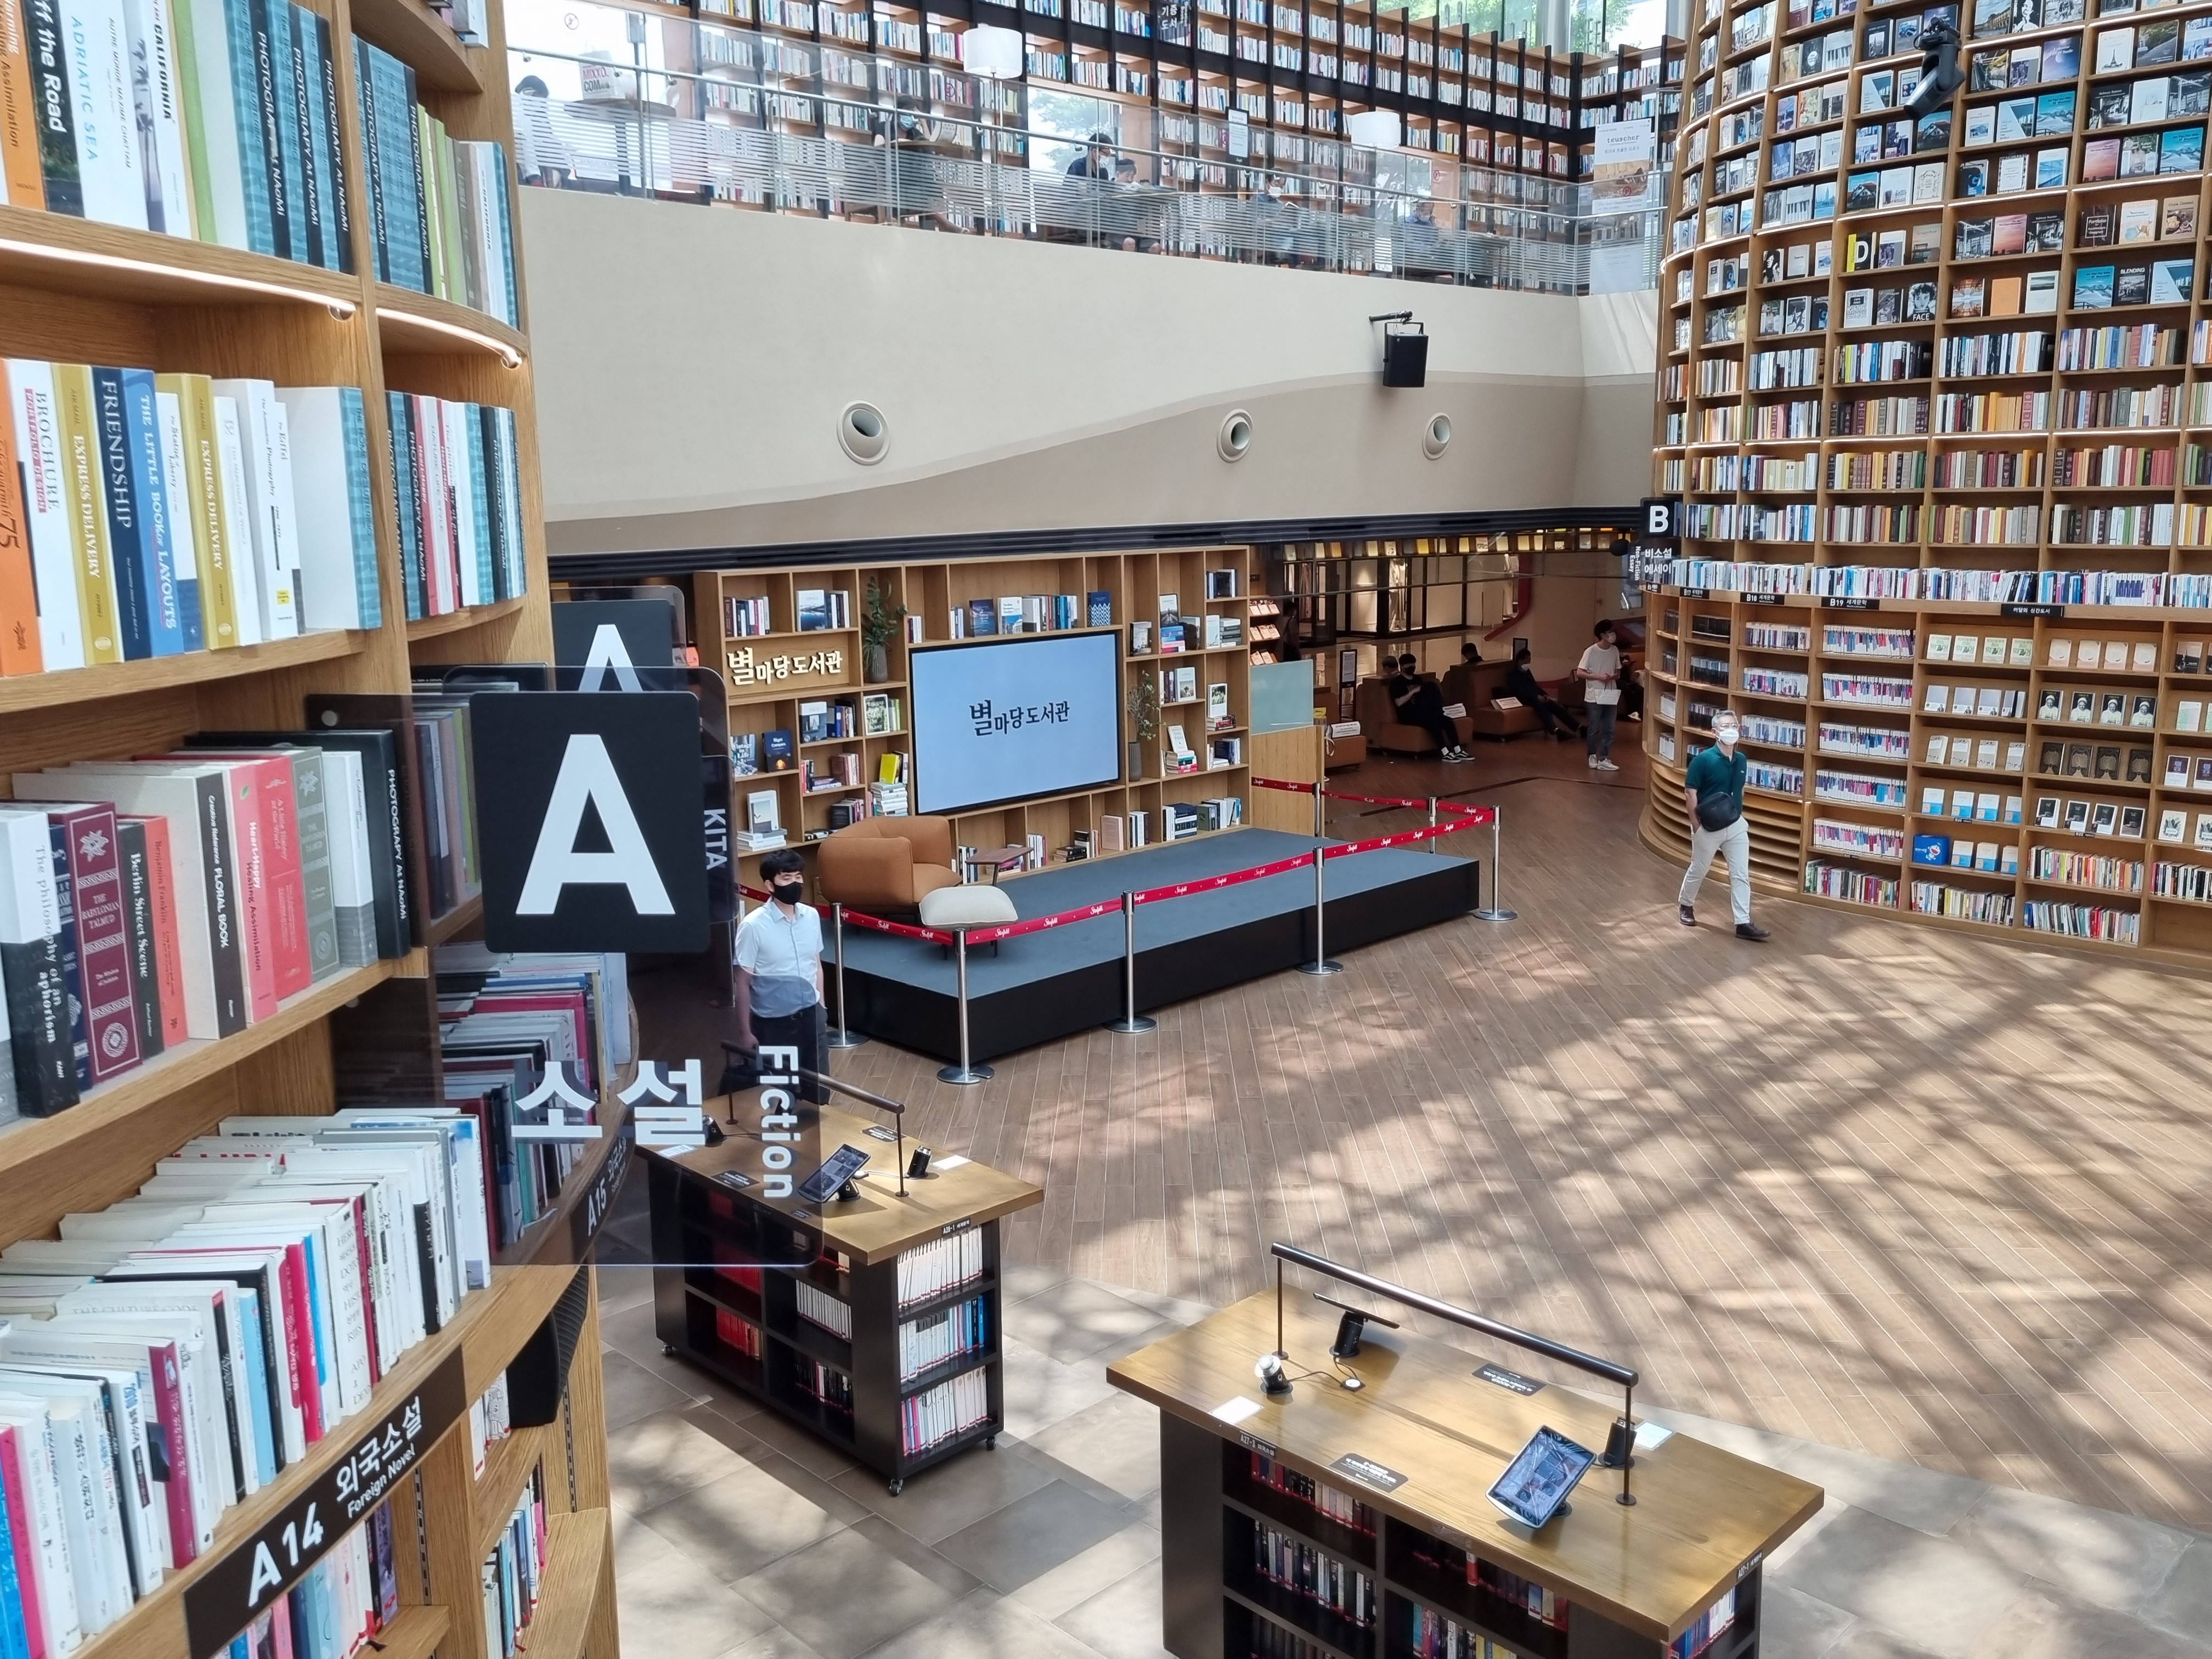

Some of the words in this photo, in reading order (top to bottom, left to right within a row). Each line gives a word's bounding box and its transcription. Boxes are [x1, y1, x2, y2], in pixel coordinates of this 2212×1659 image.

[35, 0, 54, 24] ff
[1160, 17, 1177, 30] 도서
[1161, 4, 1177, 16] 기증
[37, 29, 56, 65] the
[109, 18, 118, 48] AUTRE
[71, 16, 93, 114] ADRIATIC
[83, 122, 98, 161] SEA
[111, 51, 122, 84] MONDE
[154, 24, 172, 121] CALIFORNIA
[1, 60, 20, 148] Assimilation
[42, 73, 66, 133] Road
[117, 87, 127, 123] MAXIME
[293, 48, 312, 157] PHOTOGRAPY
[325, 59, 342, 163] PHOTOGRAPY
[121, 125, 132, 168] CHATTAM
[364, 81, 381, 182] PHOTOGRAPY
[409, 105, 425, 200] PHOTOGRAPY
[1607, 134, 1640, 144] teuscher
[1912, 313, 1930, 321] FACE
[140, 395, 152, 426] THE
[35, 392, 60, 510] BROCHURE
[101, 379, 132, 529] FRIENDSHIP
[145, 432, 159, 485] LITTLE
[200, 439, 215, 499] EXPRESS
[279, 432, 288, 461] Eiffel
[409, 431, 422, 527] PHOTOGRAPY
[493, 439, 503, 521] PHOTOGRAPY
[73, 435, 91, 501] EXPRESS
[82, 503, 100, 579] DELIVERY
[151, 492, 165, 534] BOOK
[1649, 505, 1669, 533] B
[207, 502, 223, 570] DELIVERY
[1645, 548, 1672, 558] 비소설
[158, 550, 177, 629] LAYOUTS
[1645, 563, 1672, 574] 에세이
[727, 647, 843, 686] 별마당도서관
[969, 699, 1070, 736] 별마당도서관
[387, 769, 402, 860] PHOTOGRAPY
[516, 734, 676, 915] A
[35, 845, 46, 874] The
[250, 822, 262, 889] Heart-Happy
[704, 808, 728, 870] KITA
[130, 853, 143, 895] Berlin
[154, 840, 164, 884] Benjamin
[246, 863, 256, 903] Healing
[157, 886, 167, 924] Franklin
[213, 867, 226, 912] FLORAL
[40, 879, 57, 962] philosophy
[134, 897, 146, 936] Street
[218, 914, 229, 948] BOOK
[250, 906, 261, 972] Assimilation
[50, 968, 61, 983] of
[137, 938, 149, 978] Scene
[38, 972, 57, 1043] aphorism
[52, 989, 63, 1006] an
[511, 1059, 706, 1146] 소설
[759, 1046, 801, 1198] Fiction
[588, 1177, 606, 1237] A15
[1240, 1434, 1256, 1448] A27-3
[248, 1502, 325, 1607] A14
[336, 1396, 422, 1502] 외국소설
[348, 1474, 387, 1518] Foreign
[387, 1443, 416, 1481] Novel
